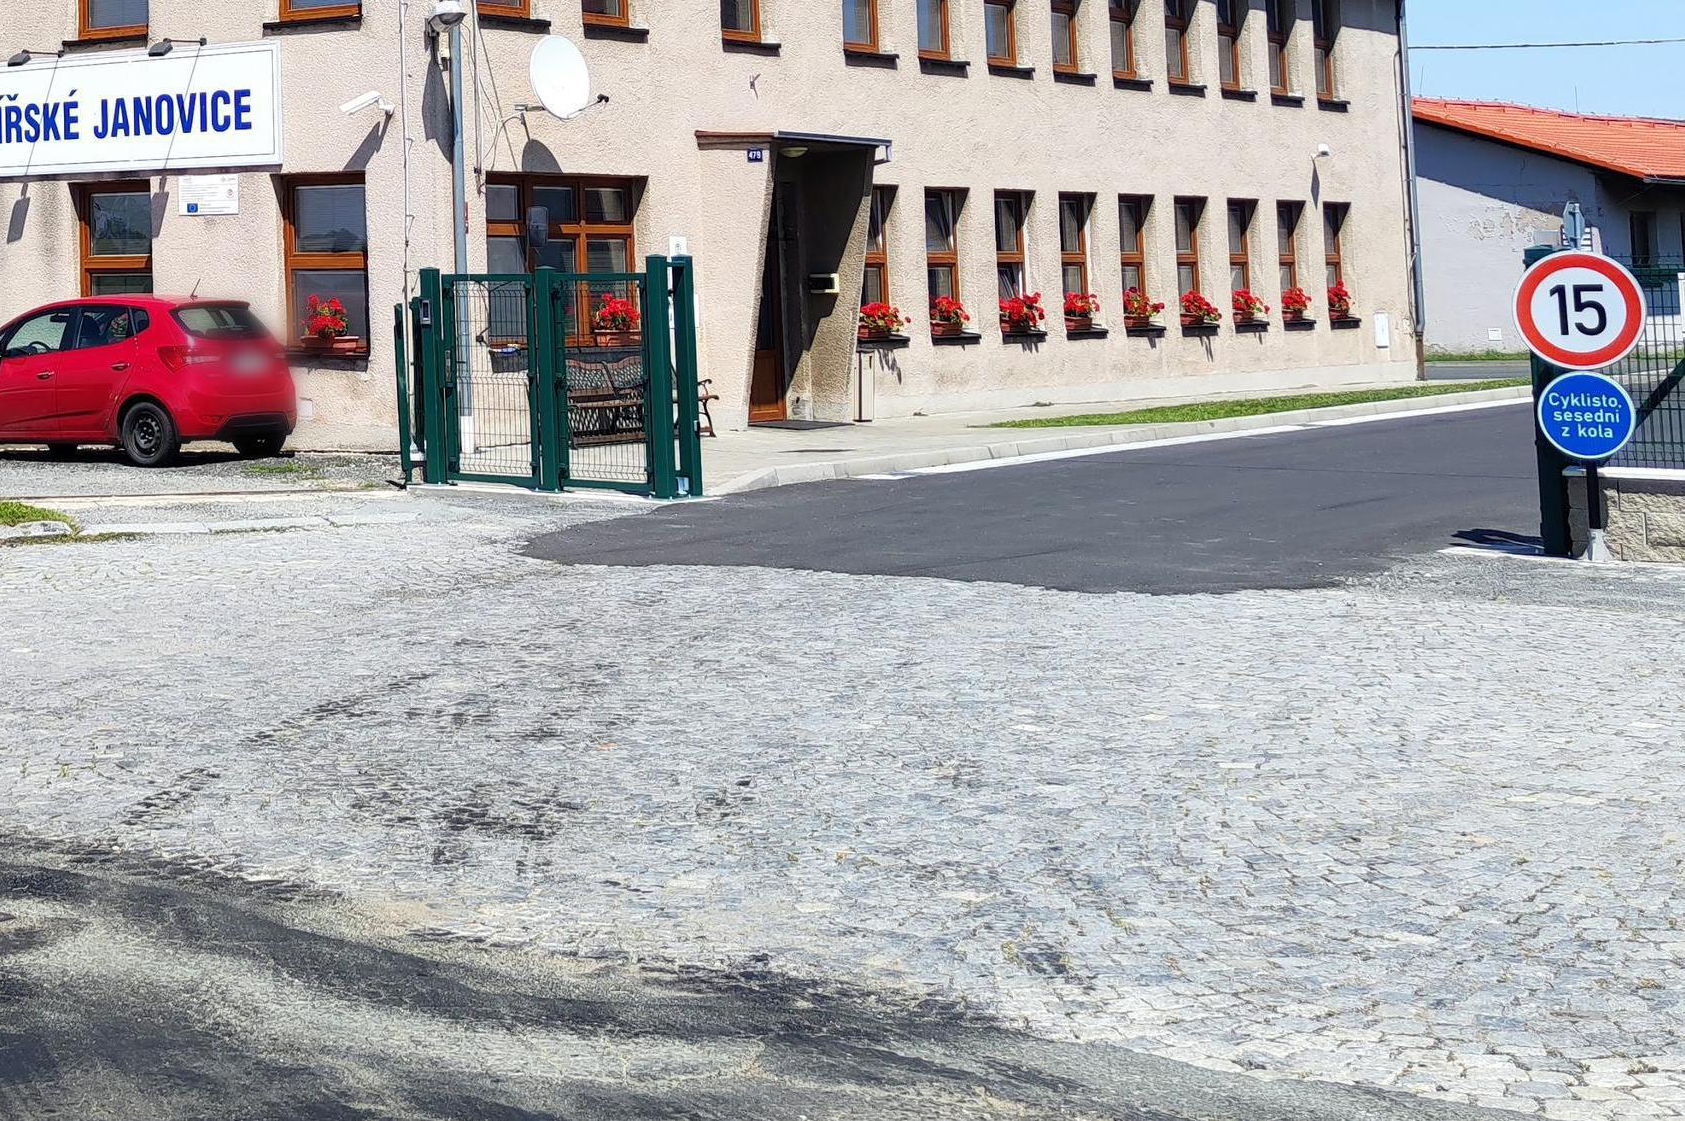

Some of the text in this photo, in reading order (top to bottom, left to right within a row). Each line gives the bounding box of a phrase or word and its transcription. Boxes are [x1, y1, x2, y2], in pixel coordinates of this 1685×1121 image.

[94, 89, 252, 139] JANOVICE
[1549, 284, 1607, 336] 15
[1553, 409, 1620, 423] sesedni
[1561, 423, 1613, 438] z kola
